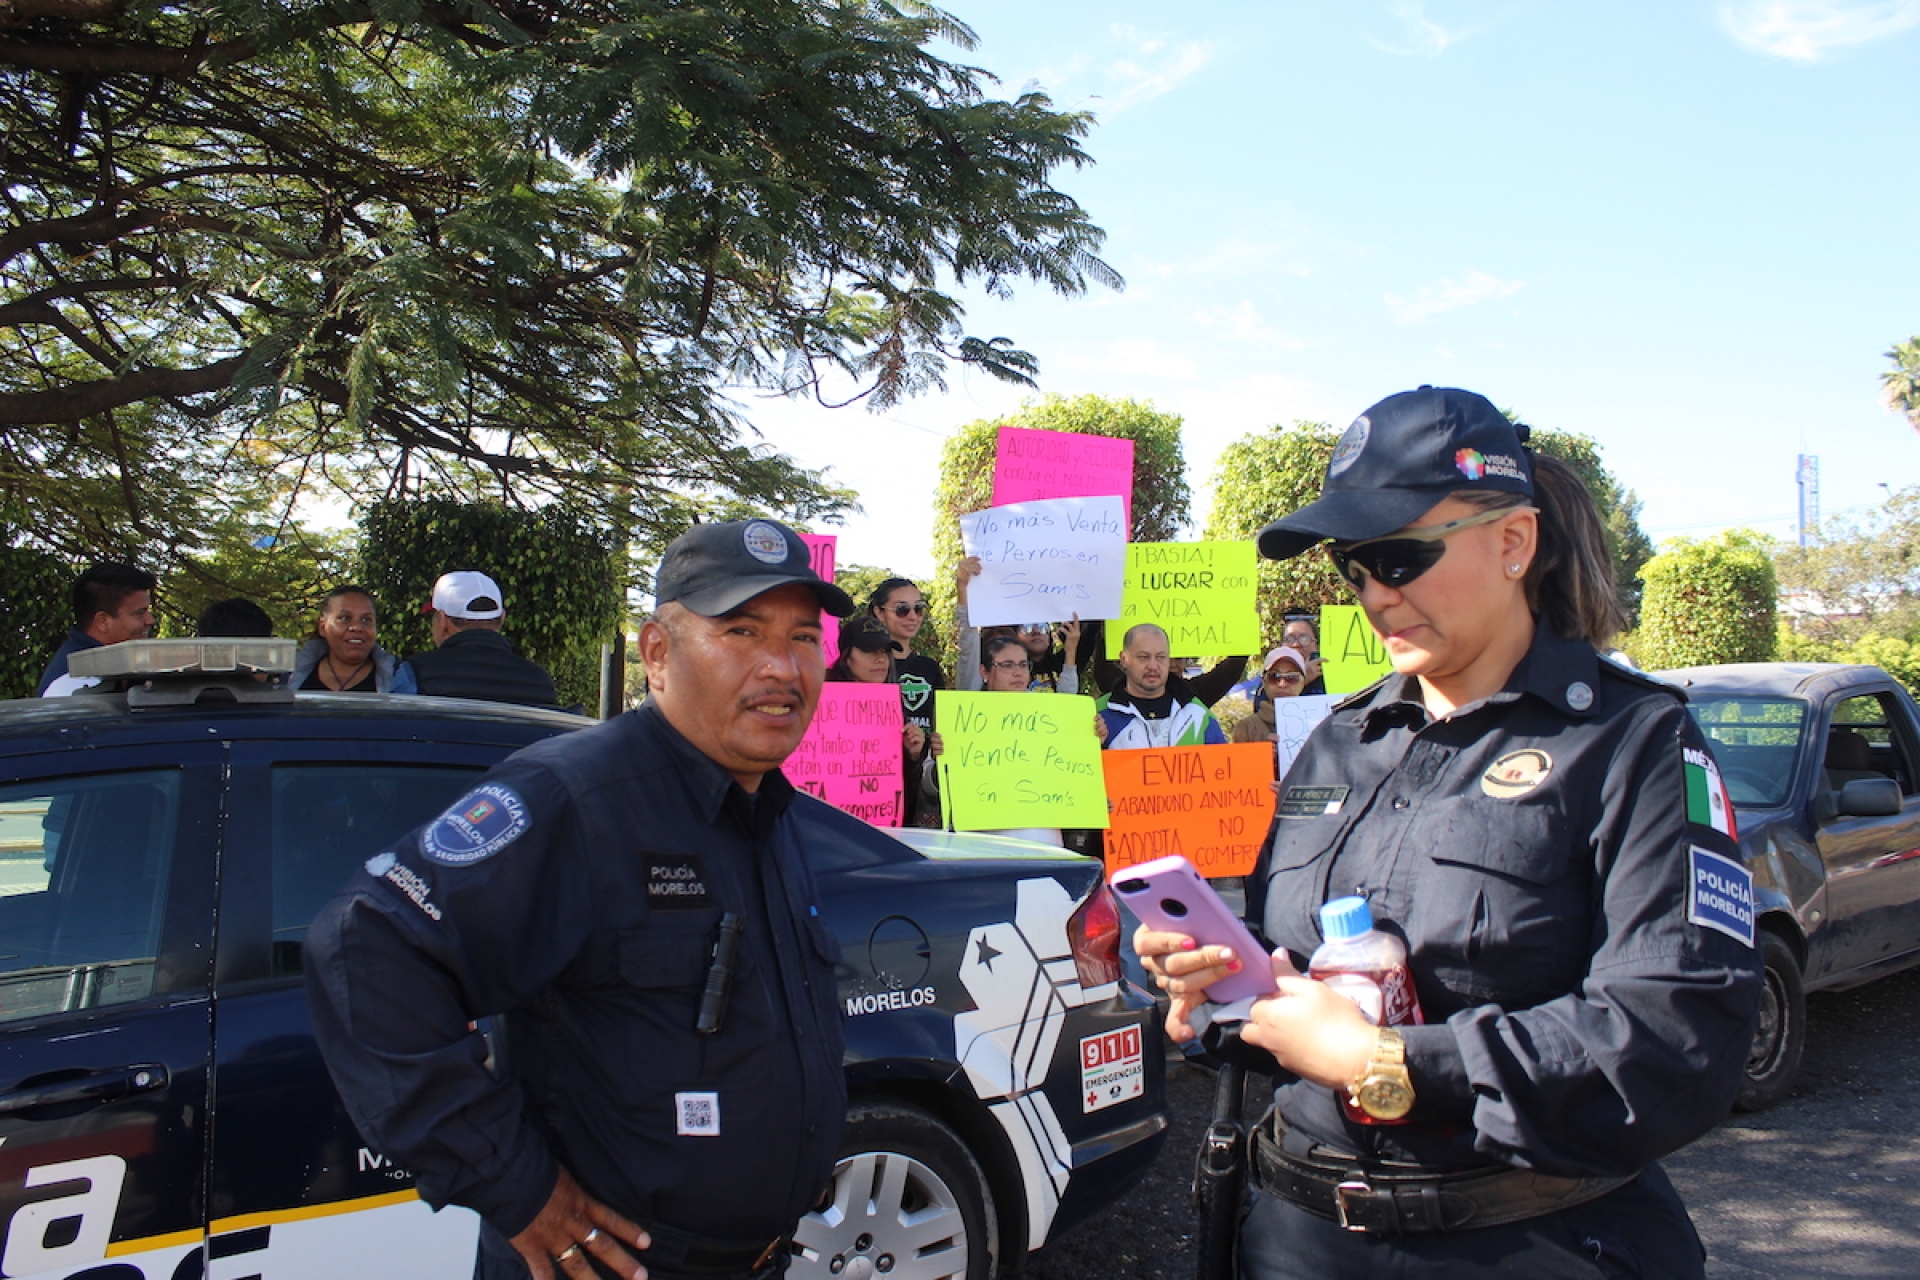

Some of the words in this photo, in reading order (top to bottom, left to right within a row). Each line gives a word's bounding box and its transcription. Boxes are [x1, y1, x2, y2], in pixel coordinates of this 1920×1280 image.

[1004, 462, 1041, 483] contra
[1043, 468, 1057, 484] el
[1484, 454, 1517, 468] VISIÓN
[1485, 465, 1528, 483] MORELOS
[974, 514, 999, 539] No
[1008, 511, 1055, 529] más
[1066, 508, 1121, 536] Venta
[975, 540, 993, 563] de
[1002, 540, 1071, 564] Perros
[1076, 551, 1099, 566] en
[1135, 546, 1214, 568] ¡BASTA!
[1000, 573, 1091, 600] Sam's
[1123, 578, 1132, 589] e
[1141, 571, 1214, 590] LUCRAR
[1221, 576, 1249, 589] con
[1124, 603, 1137, 617] a
[1147, 598, 1202, 618] VIDA
[1170, 622, 1233, 644] IMAL
[1001, 710, 1058, 734] más
[800, 741, 818, 759] ay
[822, 732, 855, 755] tantos
[861, 739, 881, 763] que
[960, 739, 1031, 768] Vende
[1043, 745, 1095, 776] Perros
[827, 761, 843, 775] un
[1142, 752, 1206, 786] EVITA
[1215, 756, 1232, 781] el
[859, 777, 880, 795] NO
[1015, 778, 1075, 806] Sam's
[479, 785, 525, 821] POLICÍA
[1116, 793, 1193, 817] ABANDONO
[1199, 788, 1265, 810] ANIMAL
[1218, 815, 1245, 838] NO
[435, 848, 487, 863] SEGURIDAD
[392, 862, 431, 896] VISIÓN
[651, 864, 697, 880] POLICÍA
[386, 870, 442, 921] MORELOS
[647, 882, 706, 896] MORELOS
[1696, 868, 1750, 907] POLICÍA
[1697, 889, 1751, 927] MORELOS
[847, 986, 936, 1017] MORELOS
[1085, 1029, 1139, 1067] 911
[1084, 1064, 1143, 1090] EMERGENCIAS
